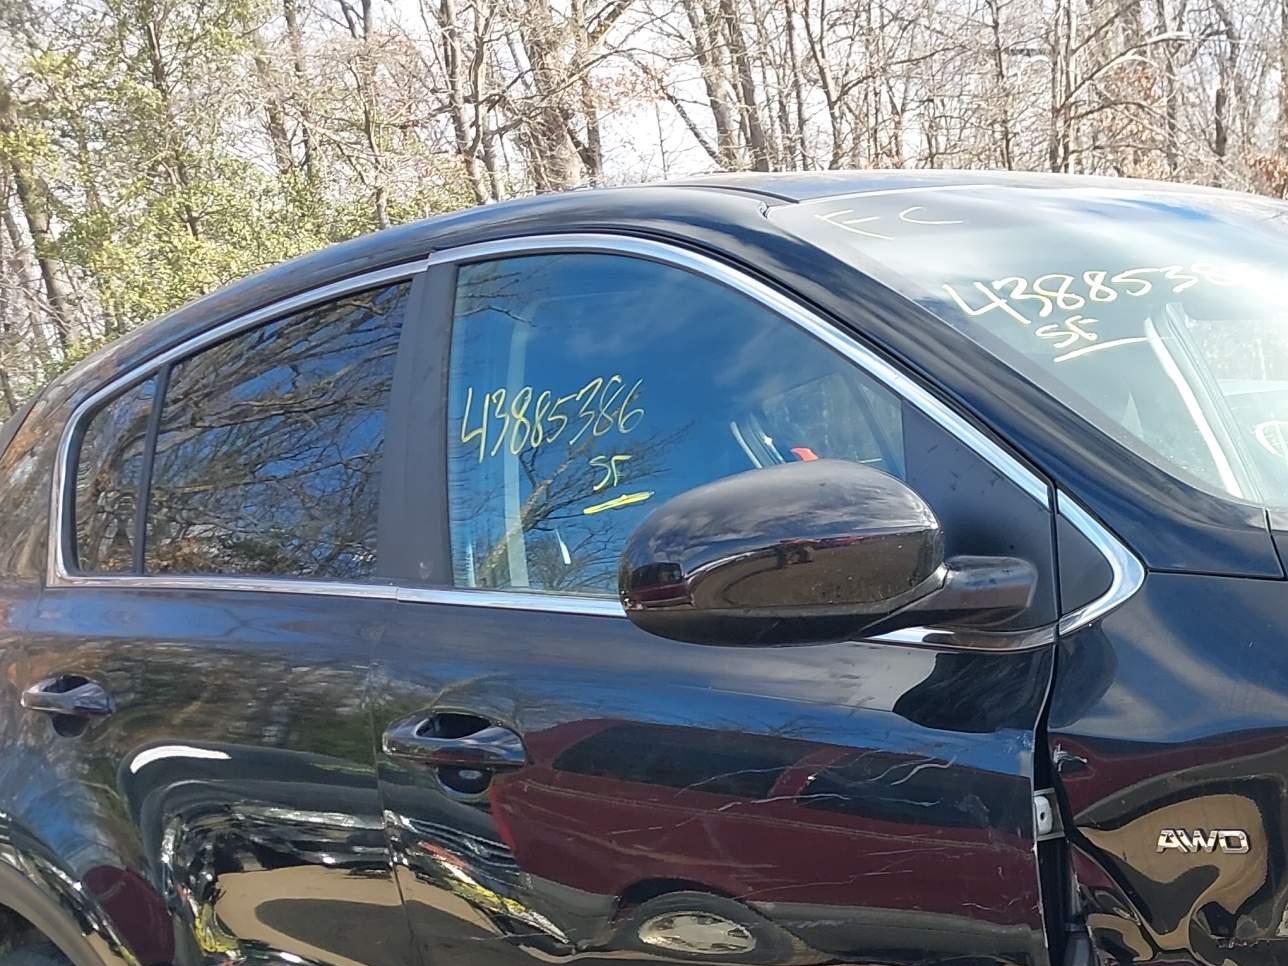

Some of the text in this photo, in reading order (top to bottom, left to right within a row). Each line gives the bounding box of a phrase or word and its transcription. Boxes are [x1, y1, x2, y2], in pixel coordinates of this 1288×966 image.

[460, 374, 645, 464] 43885386
[589, 454, 632, 491] SF
[1155, 829, 1251, 855] AWD
